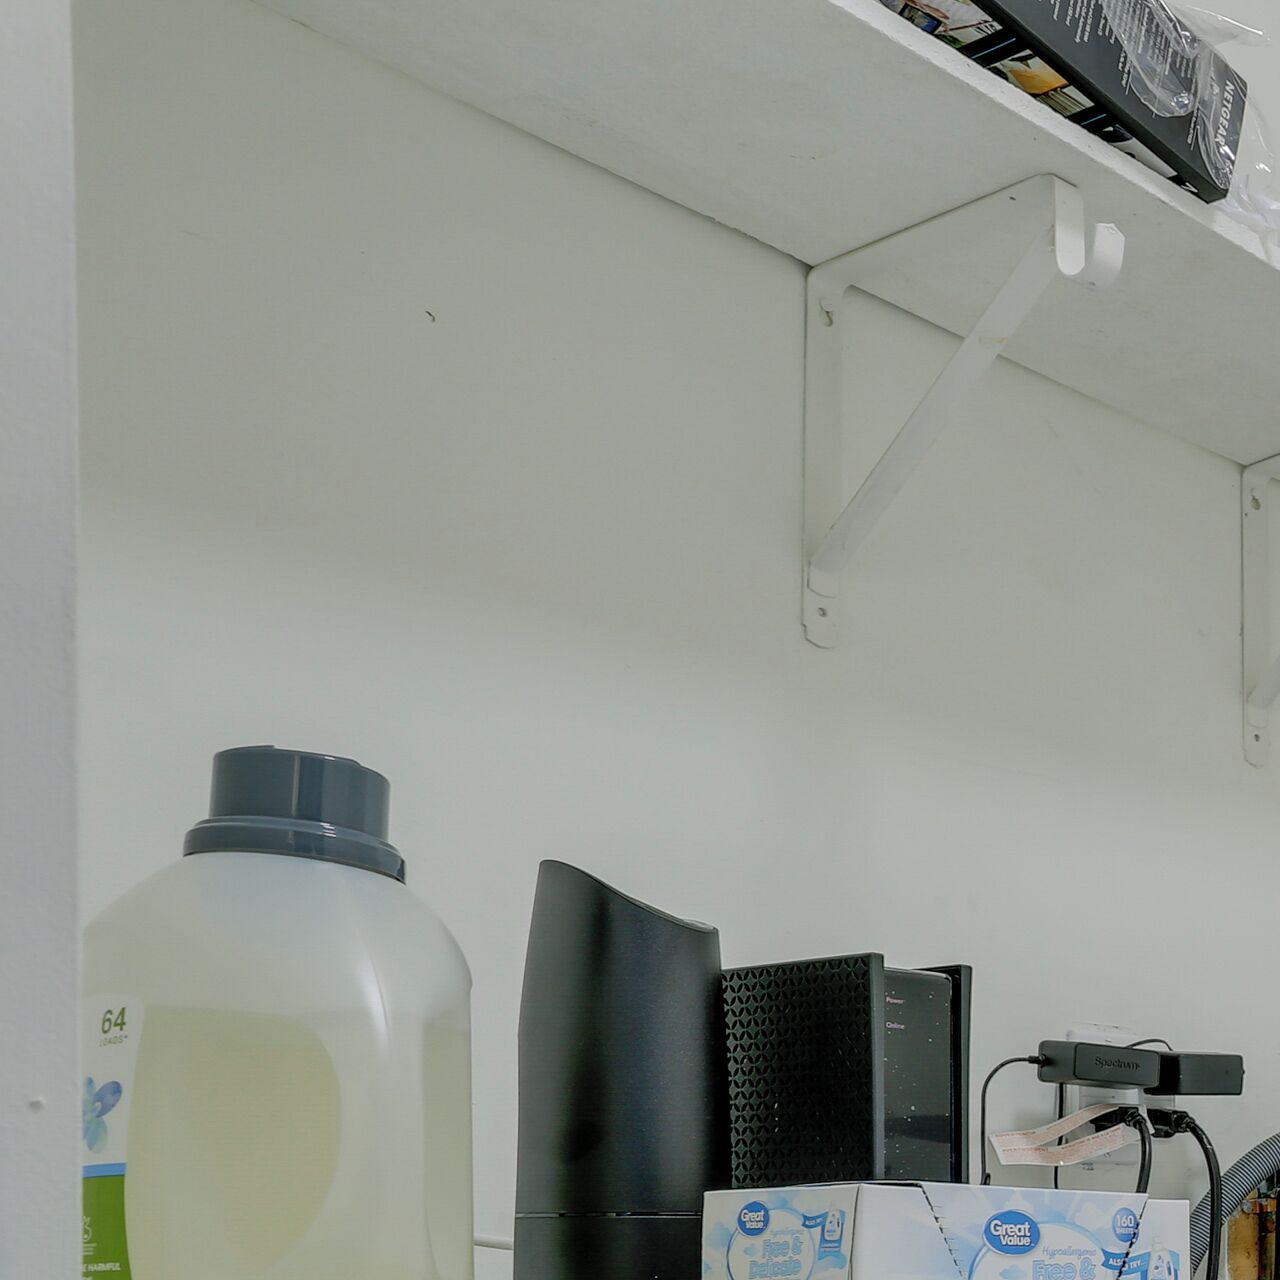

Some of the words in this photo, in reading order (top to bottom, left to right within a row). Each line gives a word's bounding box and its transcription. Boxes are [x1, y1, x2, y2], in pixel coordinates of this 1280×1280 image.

[1214, 79, 1235, 149] NETGEAR
[101, 1006, 127, 1034] 64
[740, 1209, 765, 1221] Great
[1115, 1215, 1134, 1227] 160
[989, 1219, 1031, 1237] Great
[762, 1238, 790, 1259] Free
[1000, 1234, 1031, 1246] Value
[748, 1258, 802, 1280] Delicate
[1078, 1256, 1097, 1280] &
